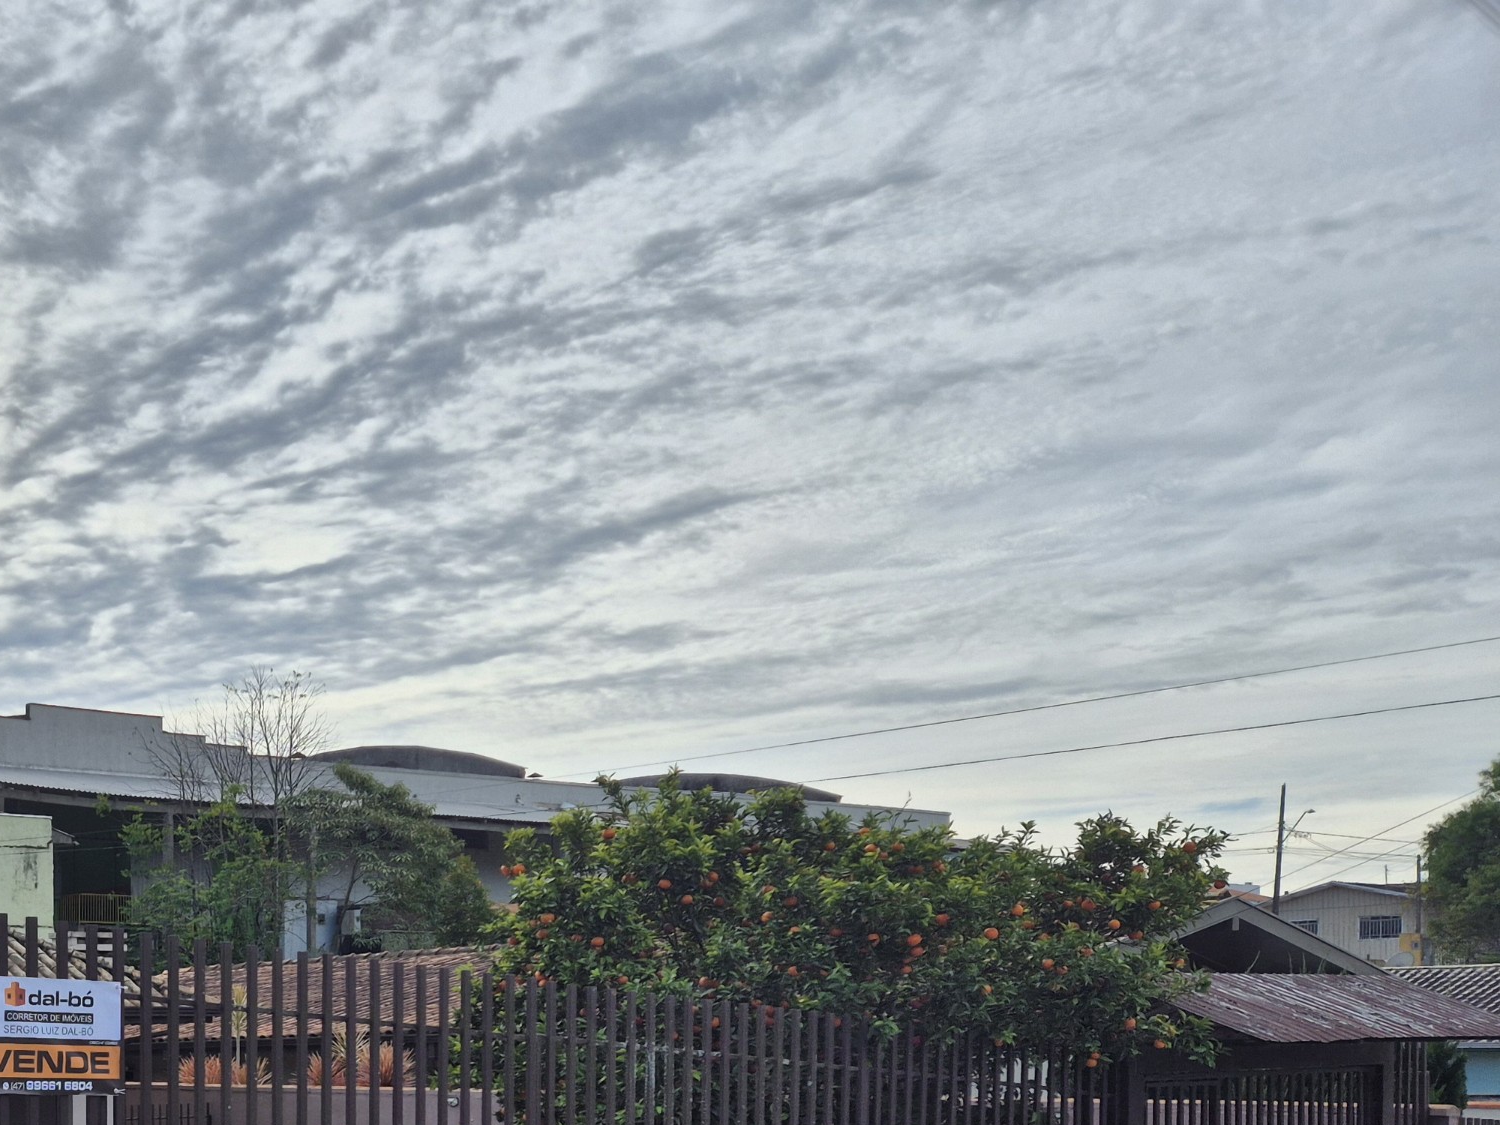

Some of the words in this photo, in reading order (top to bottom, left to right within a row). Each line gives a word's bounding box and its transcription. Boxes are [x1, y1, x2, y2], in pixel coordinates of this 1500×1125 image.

[28, 990, 94, 1008] dal-bó
[6, 1012, 49, 1022] CORRETOR
[50, 1014, 60, 1022] DE
[62, 1013, 93, 1023] IMÓVEIS
[41, 1026, 60, 1035] LUIZ
[61, 1026, 94, 1036] DAL-BÓ
[10, 1082, 25, 1091] (47)
[26, 1081, 62, 1091] 99661
[64, 1081, 93, 1091] 6804
